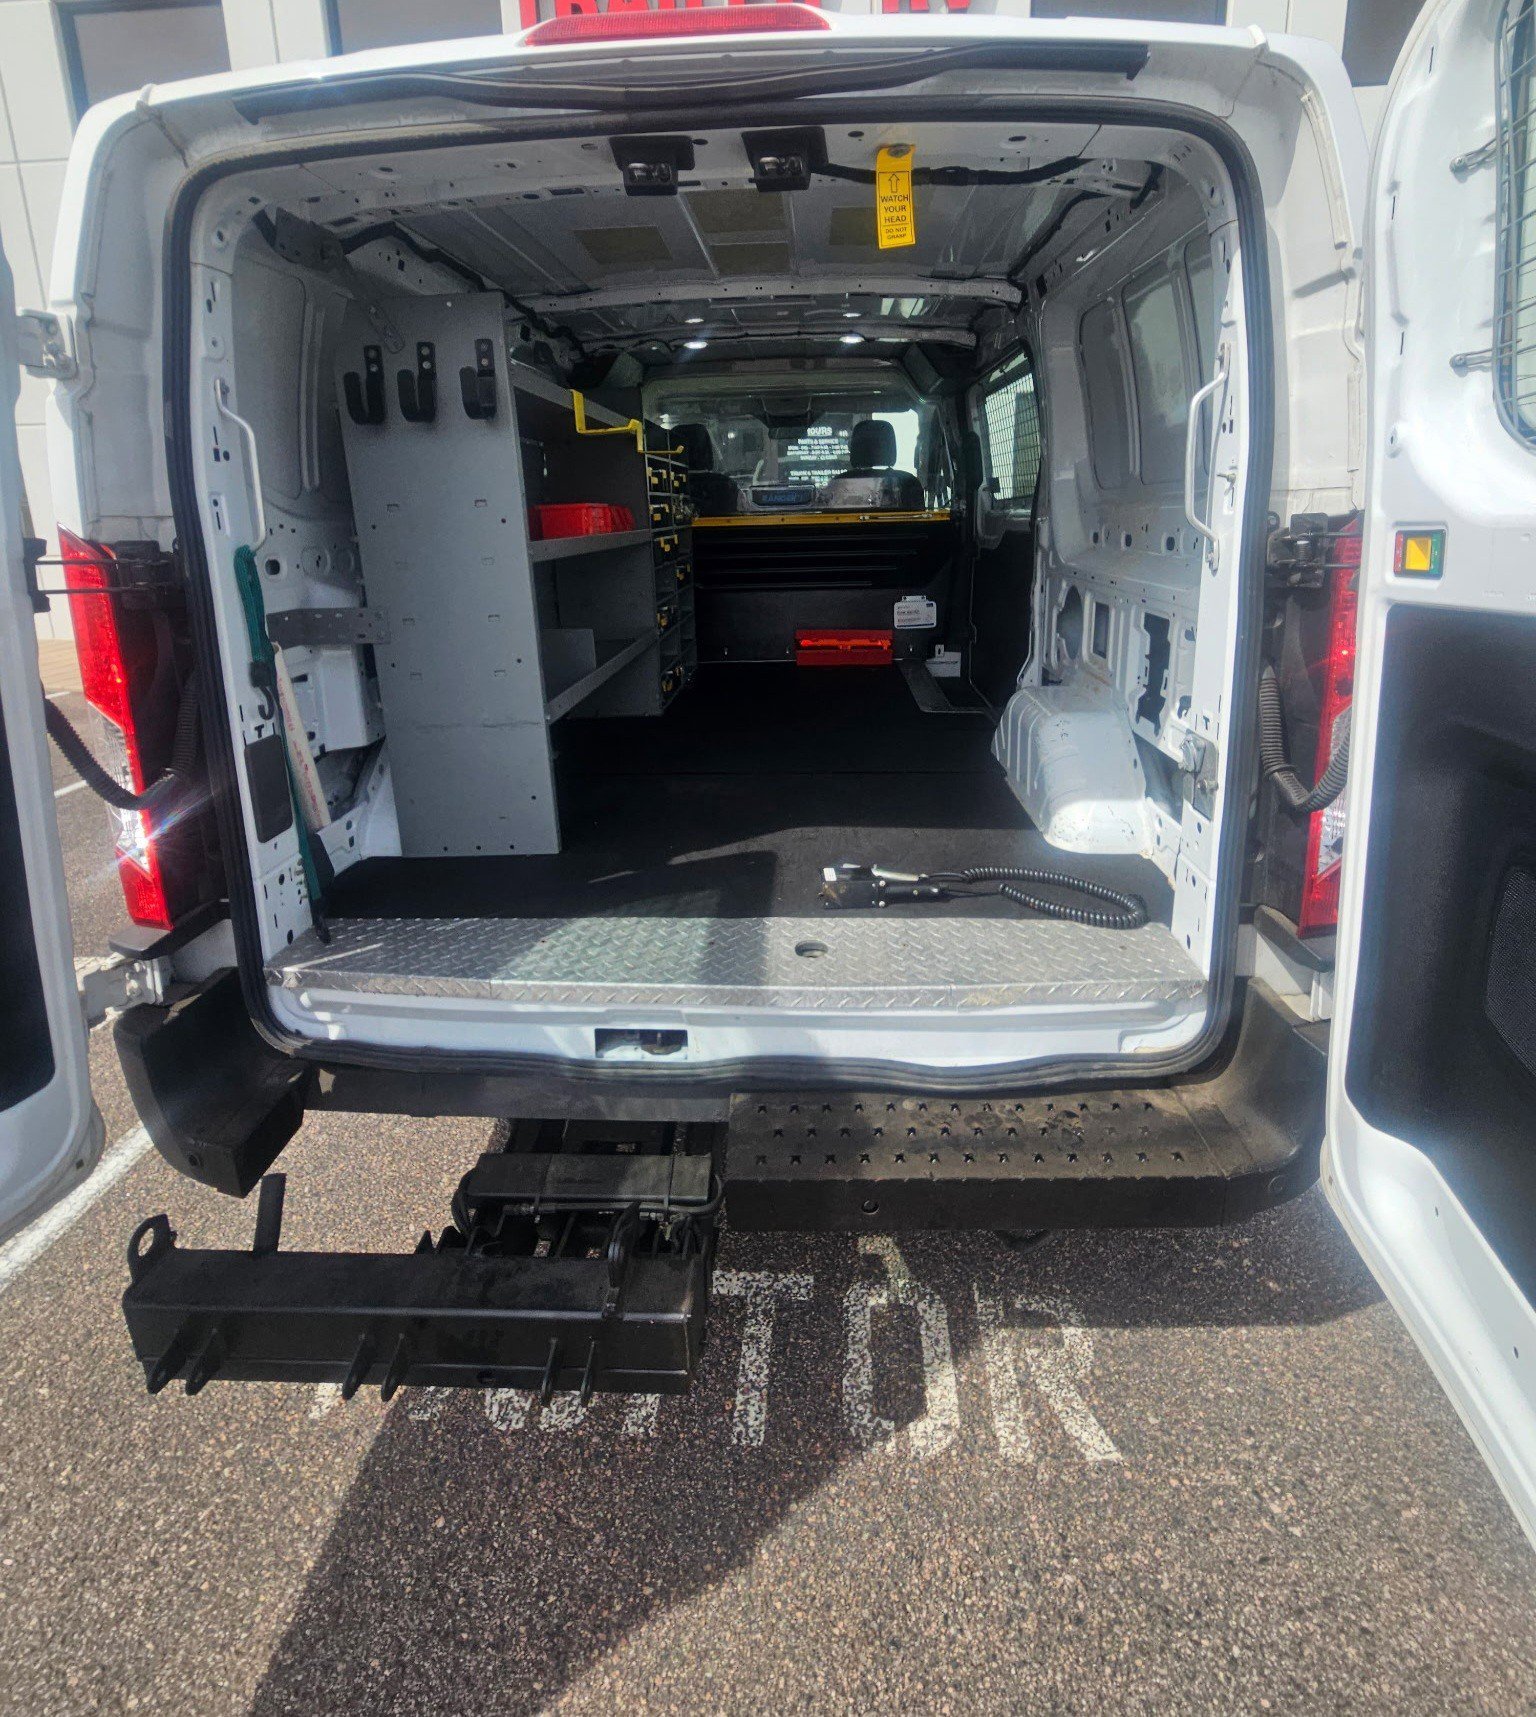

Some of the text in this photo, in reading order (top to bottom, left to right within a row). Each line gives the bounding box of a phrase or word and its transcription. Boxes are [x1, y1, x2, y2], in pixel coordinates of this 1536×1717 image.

[881, 194, 909, 203] WATCH
[884, 205, 907, 213] YOUR
[884, 215, 907, 223] HEAD
